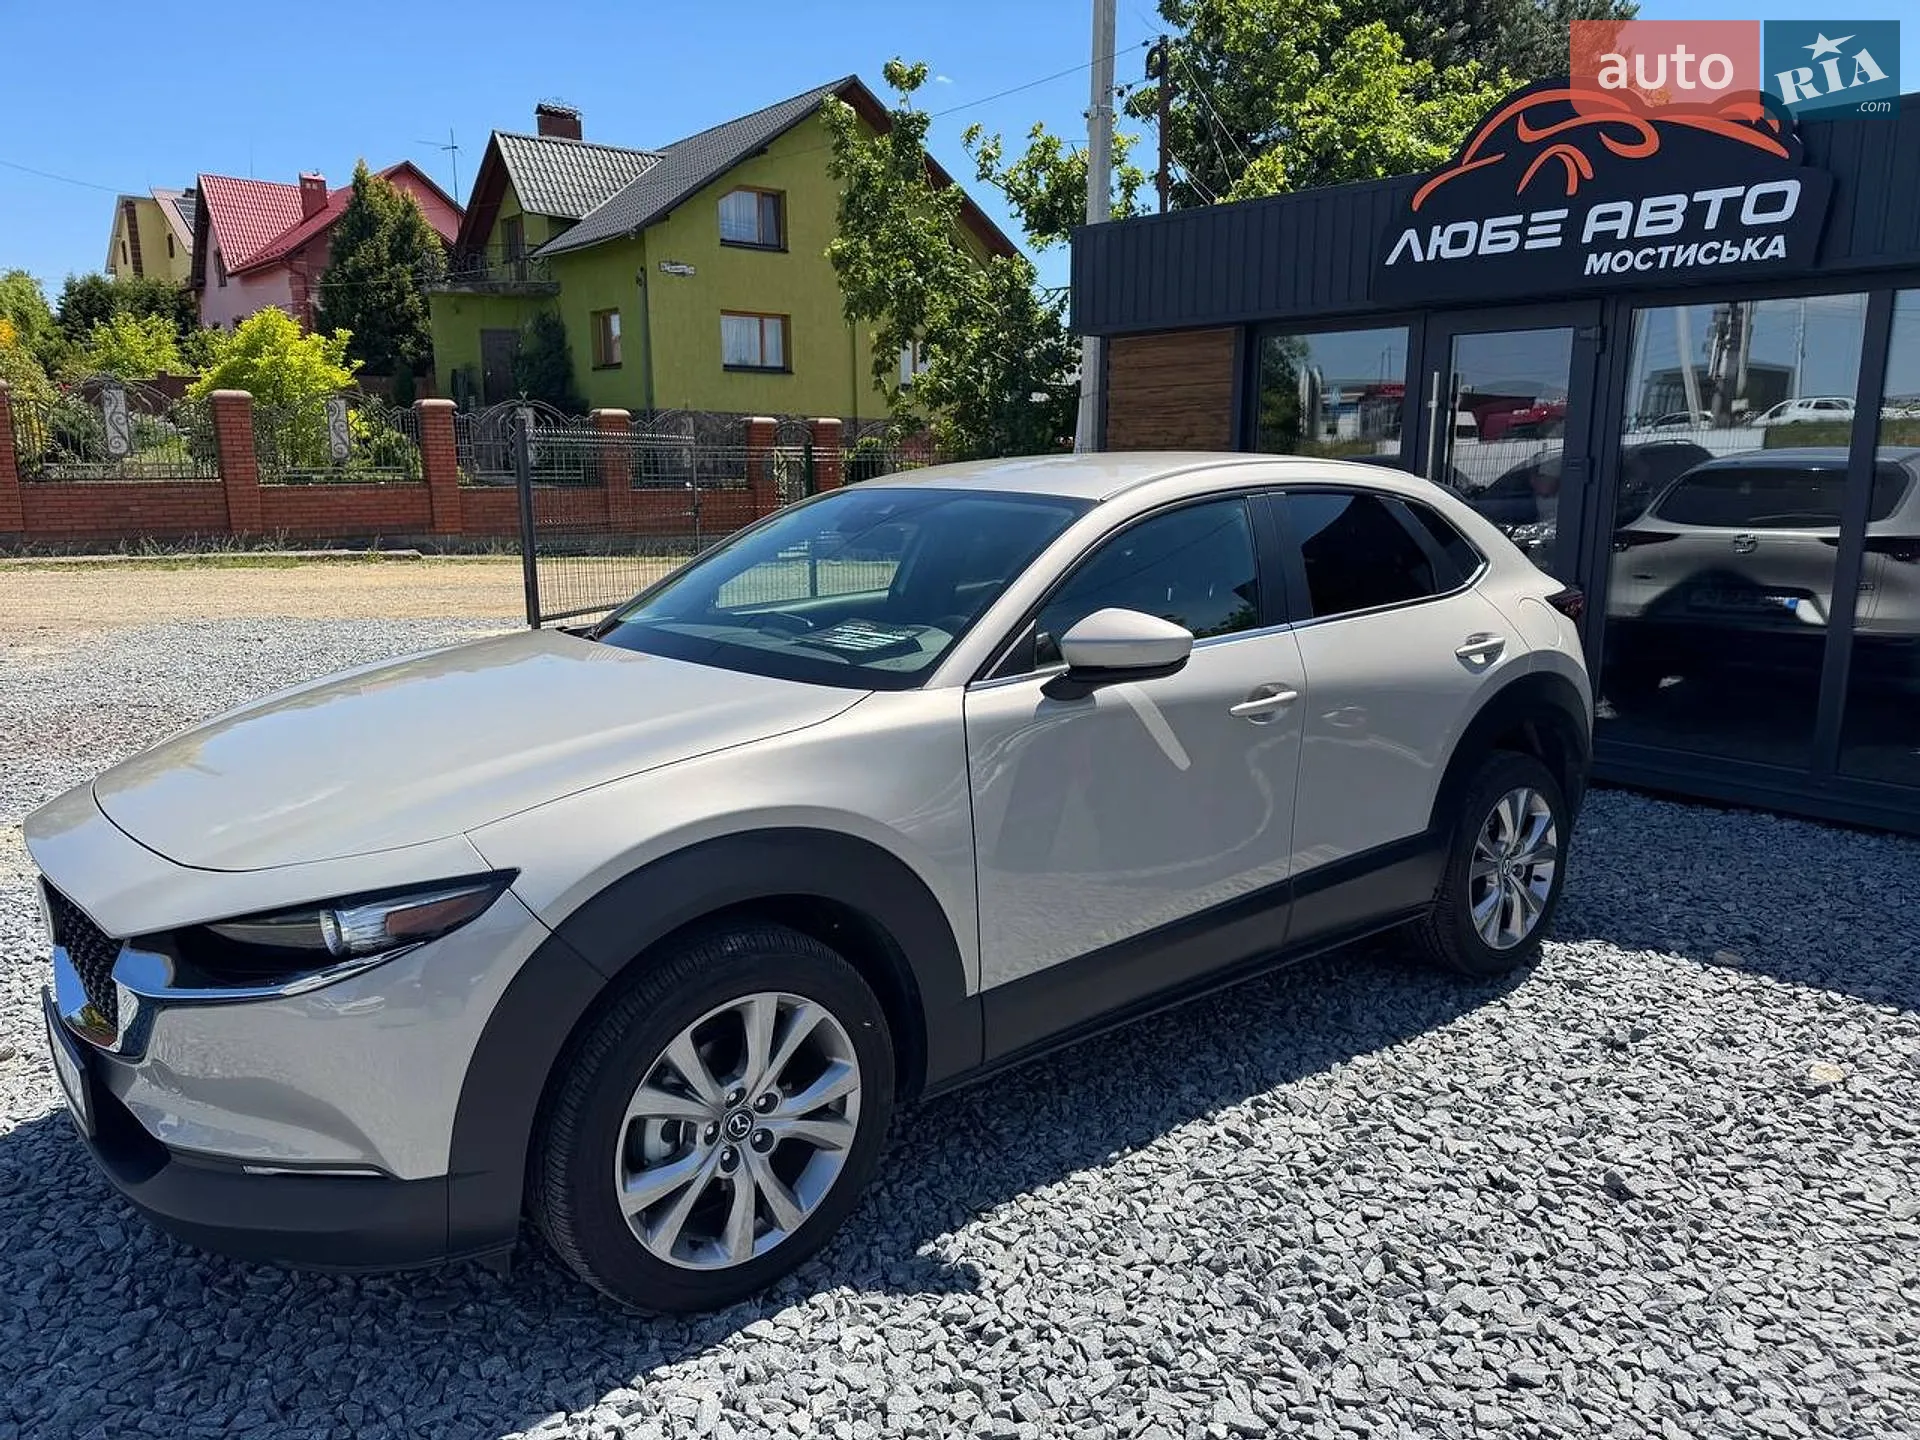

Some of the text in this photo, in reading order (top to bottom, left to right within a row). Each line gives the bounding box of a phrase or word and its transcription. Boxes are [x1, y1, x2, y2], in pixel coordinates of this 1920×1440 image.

[1385, 179, 1801, 266] ЛЮБЕ АВТО
[1584, 234, 1787, 276] МОСТИСЬКА
